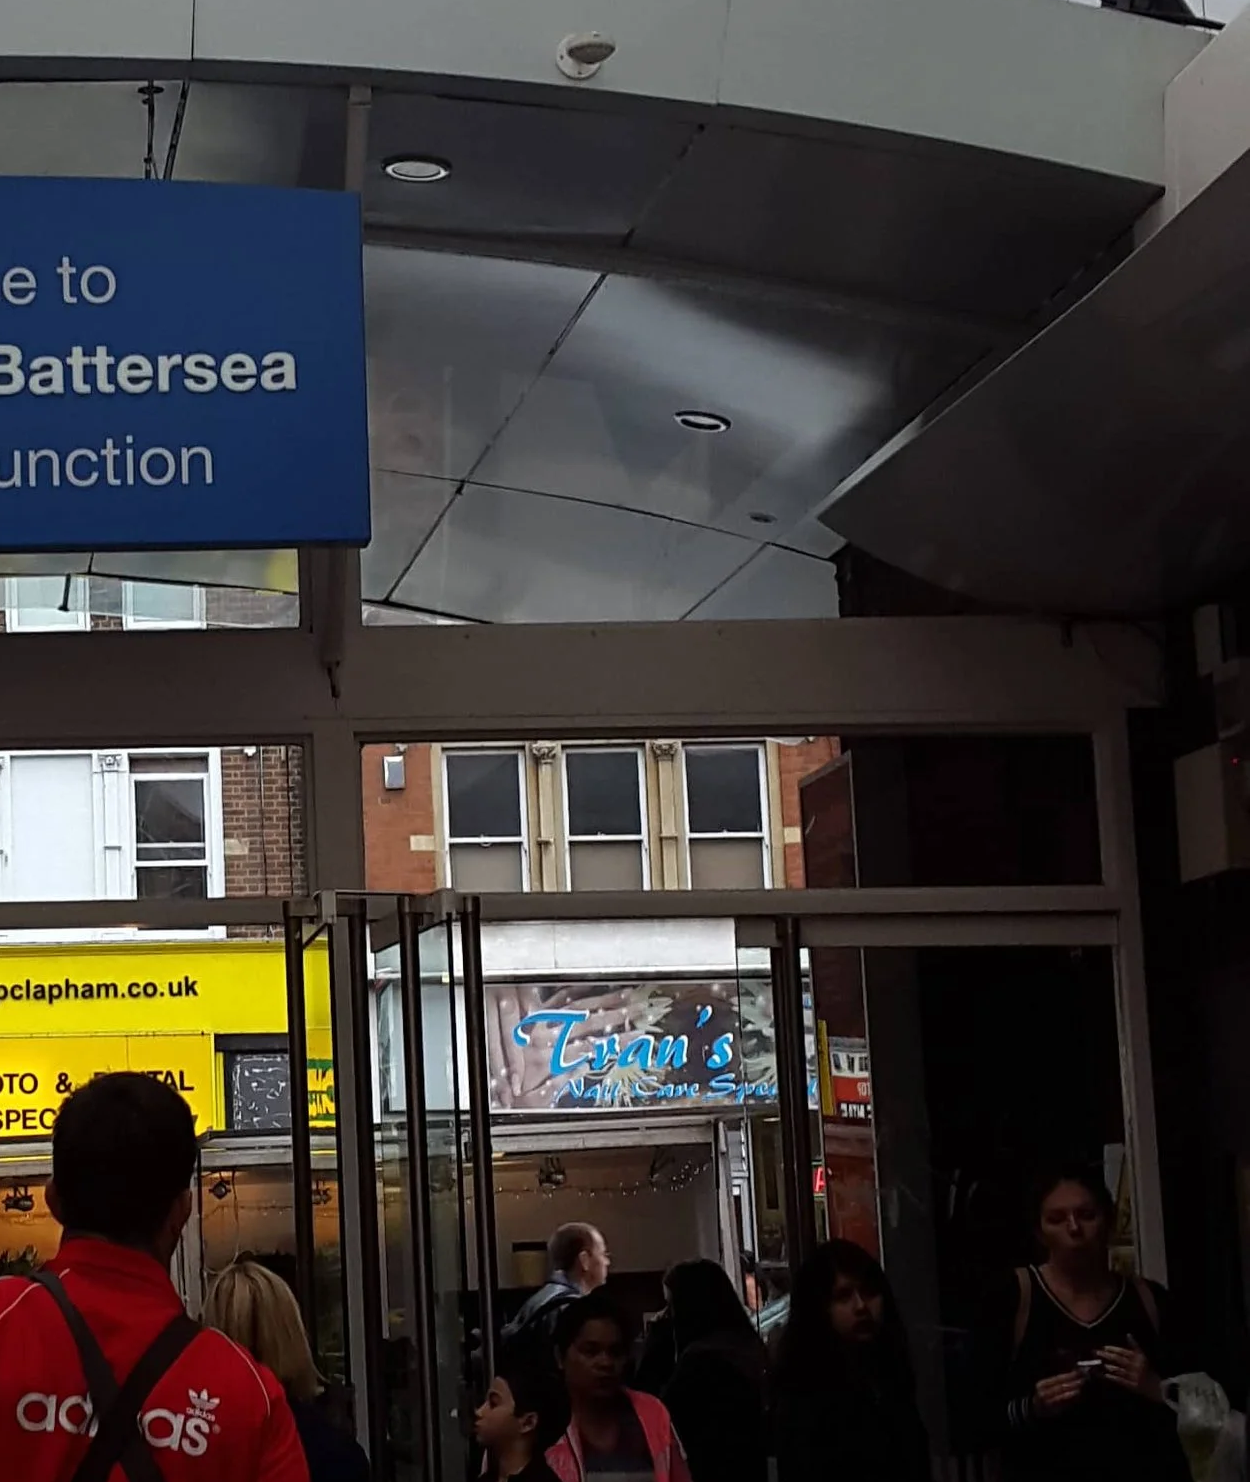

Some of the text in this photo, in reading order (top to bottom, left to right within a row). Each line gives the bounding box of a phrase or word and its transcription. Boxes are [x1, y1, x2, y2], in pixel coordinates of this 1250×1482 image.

[57, 254, 118, 307] to
[512, 1004, 734, 1078] Tran's
[55, 1071, 73, 1094] &
[631, 1075, 700, 1101] Care
[16, 1390, 210, 1457] adas
